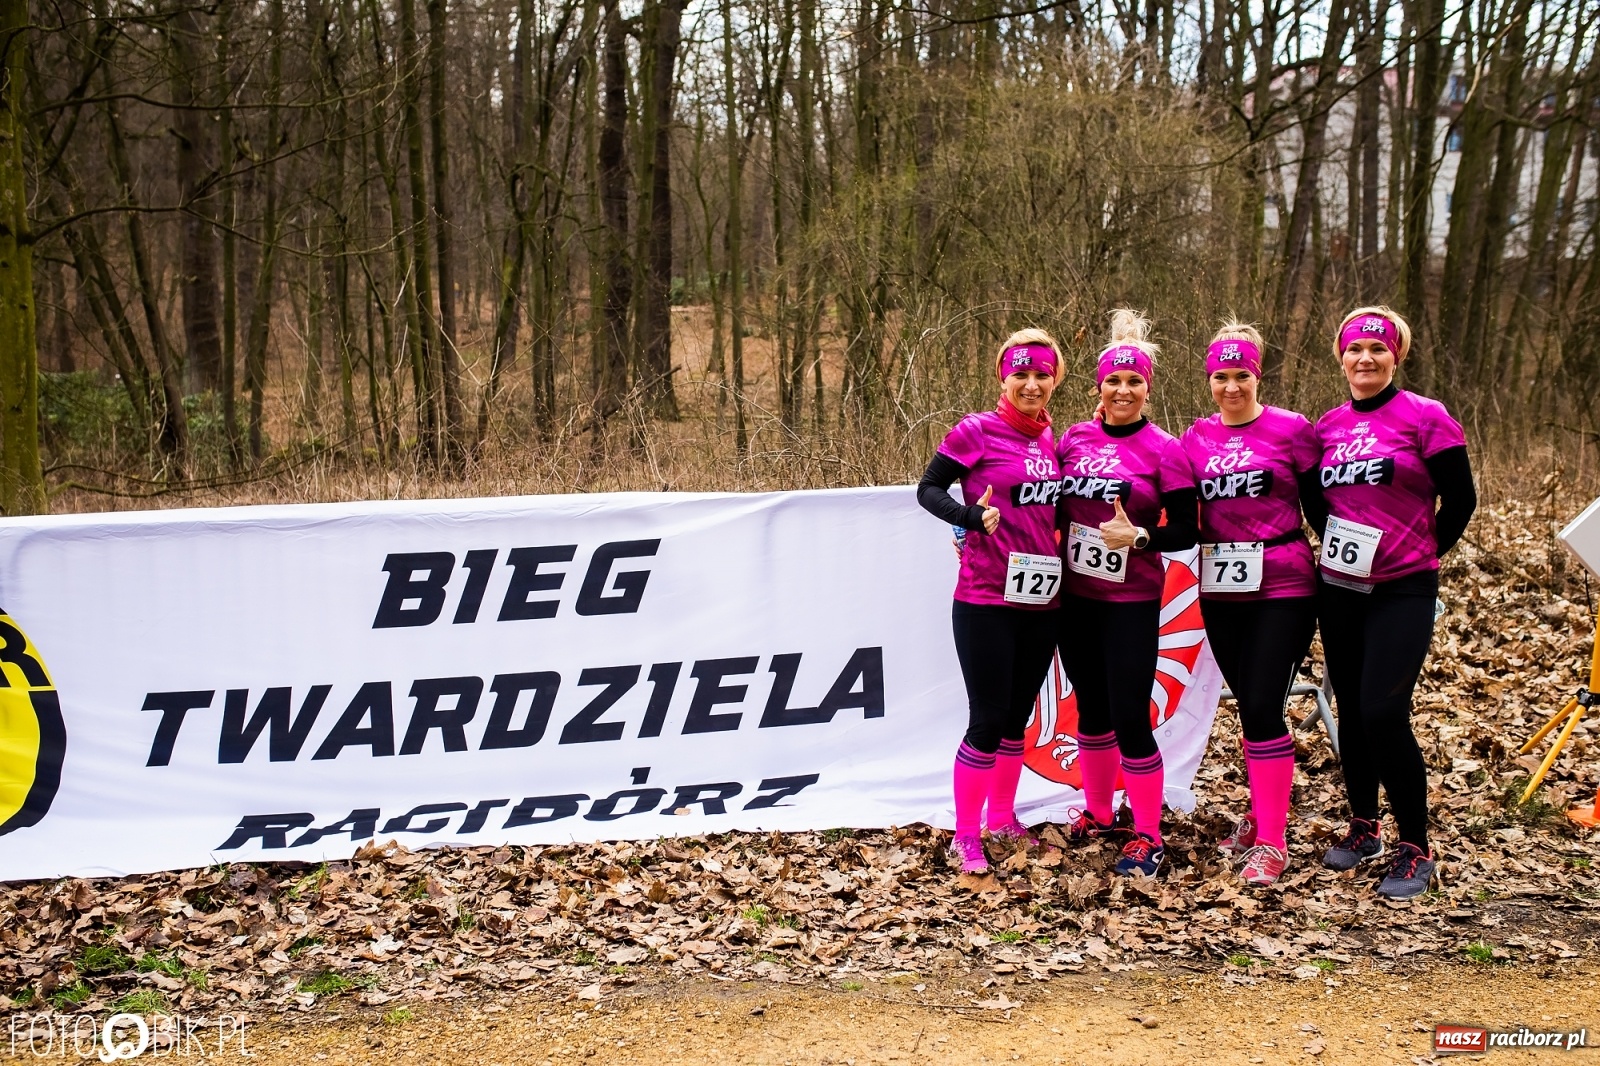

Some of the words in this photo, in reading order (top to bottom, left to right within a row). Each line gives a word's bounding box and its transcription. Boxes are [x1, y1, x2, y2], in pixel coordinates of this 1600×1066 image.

[1204, 446, 1254, 474] RÓŻ
[1330, 432, 1378, 462] RÓŻ
[1023, 454, 1057, 479] RÓŻ
[1073, 455, 1122, 475] RÓŻ
[1321, 457, 1384, 488] DUPĘ
[1200, 470, 1264, 500] DUPĘ
[1071, 541, 1123, 574] 139
[1327, 535, 1360, 565] 56
[371, 538, 662, 629] BIEG
[1012, 570, 1059, 596] 127
[1213, 560, 1248, 584] 73
[141, 646, 886, 768] TWARDZIELA
